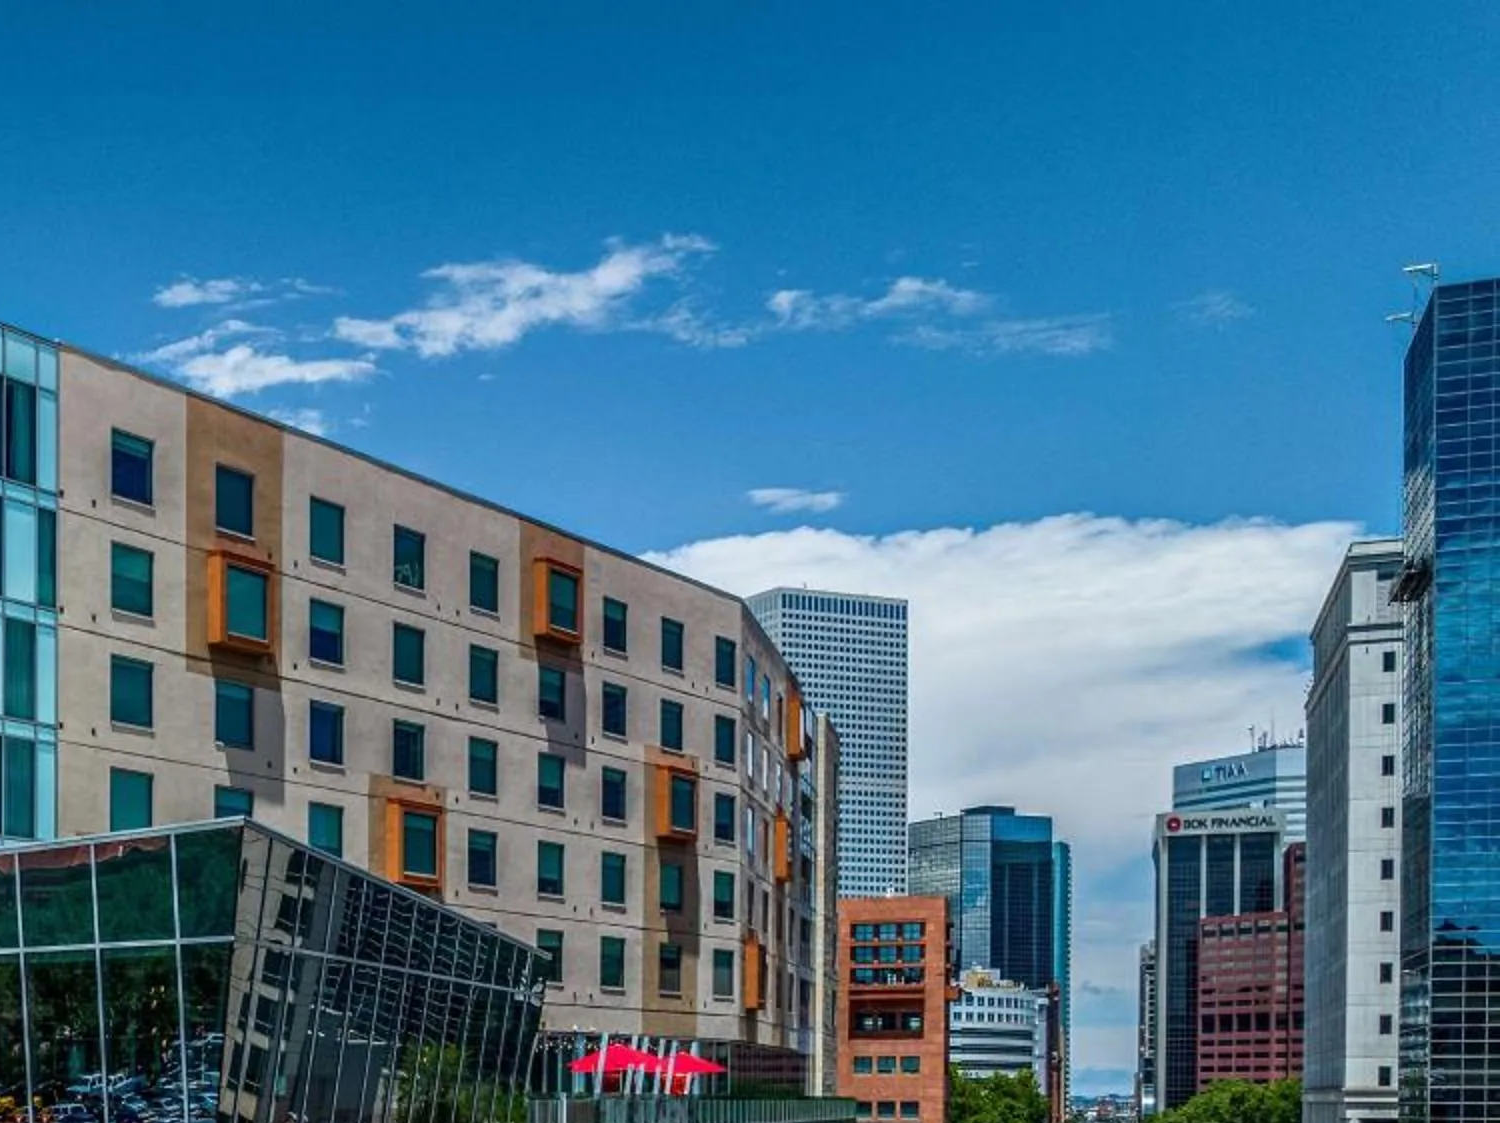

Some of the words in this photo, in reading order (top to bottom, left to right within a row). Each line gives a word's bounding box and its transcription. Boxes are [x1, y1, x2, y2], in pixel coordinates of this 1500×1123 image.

[1213, 762, 1248, 781] TIAA
[1184, 817, 1208, 830] BOK
[1211, 815, 1276, 830] FINANCIAL
